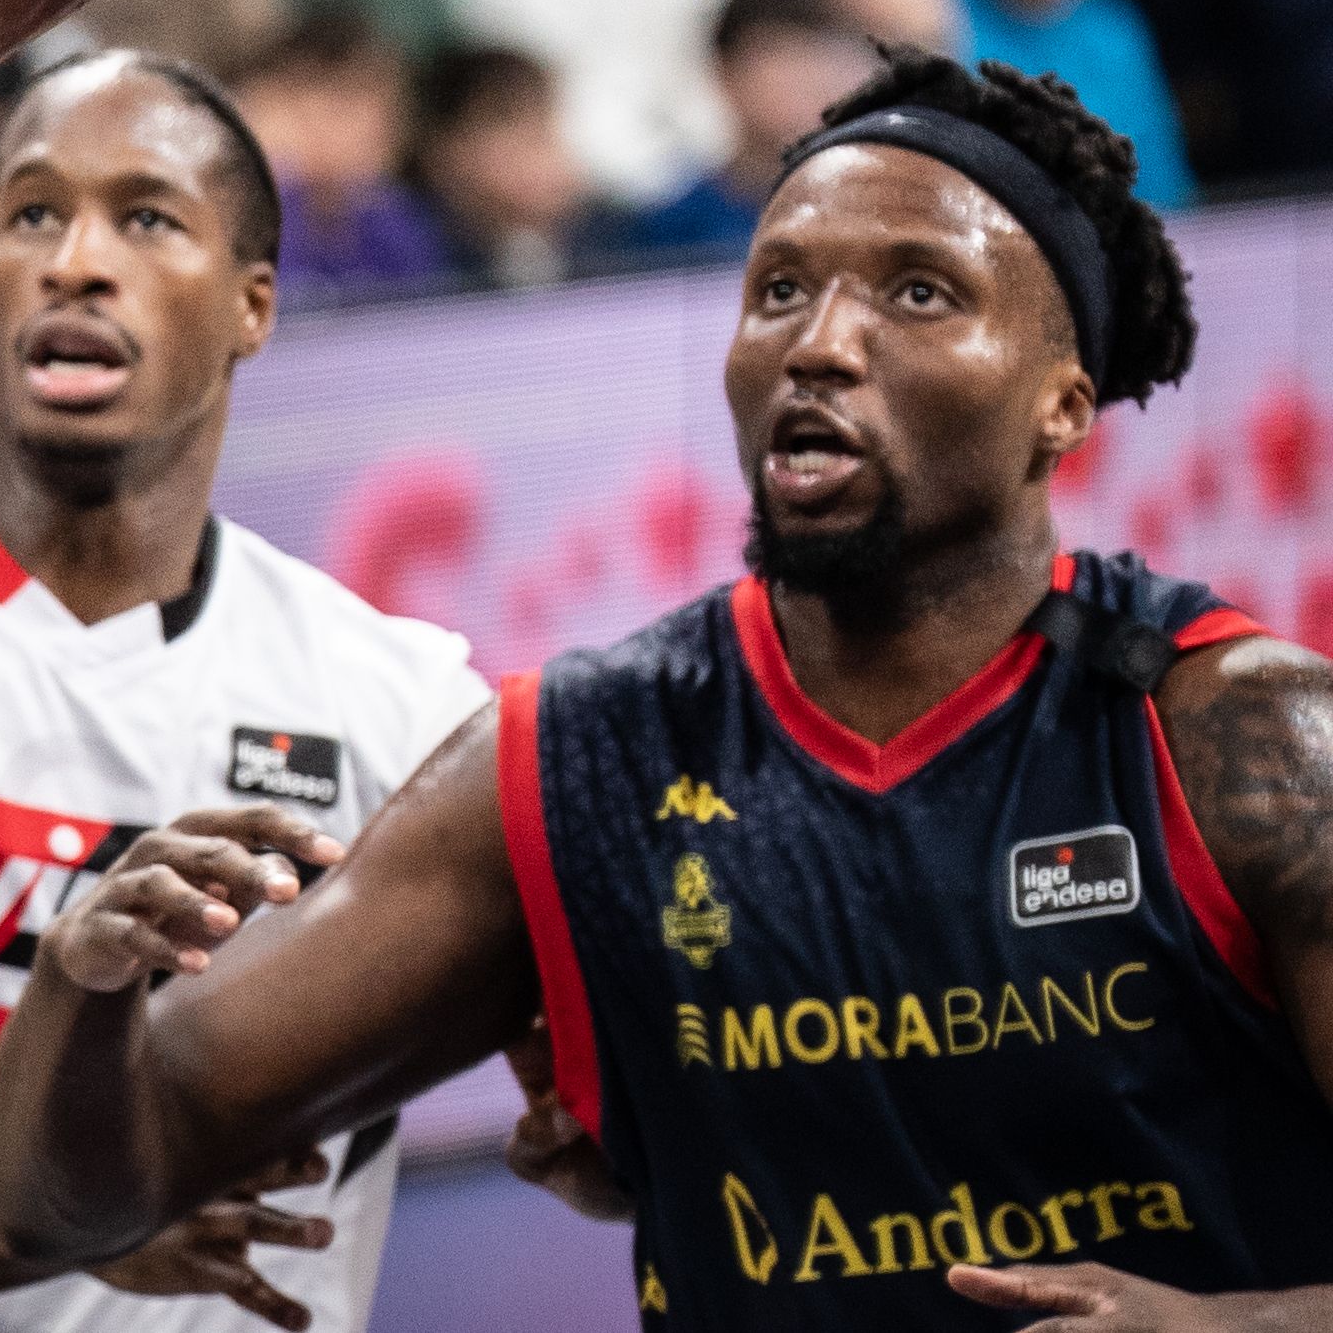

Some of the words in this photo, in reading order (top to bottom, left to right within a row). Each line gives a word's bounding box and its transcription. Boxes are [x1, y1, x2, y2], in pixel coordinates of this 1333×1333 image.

[1023, 864, 1070, 891] liga
[1024, 879, 1127, 912] endesa
[722, 962, 1156, 1070] MORABANC
[794, 1178, 1194, 1282] Andorra
